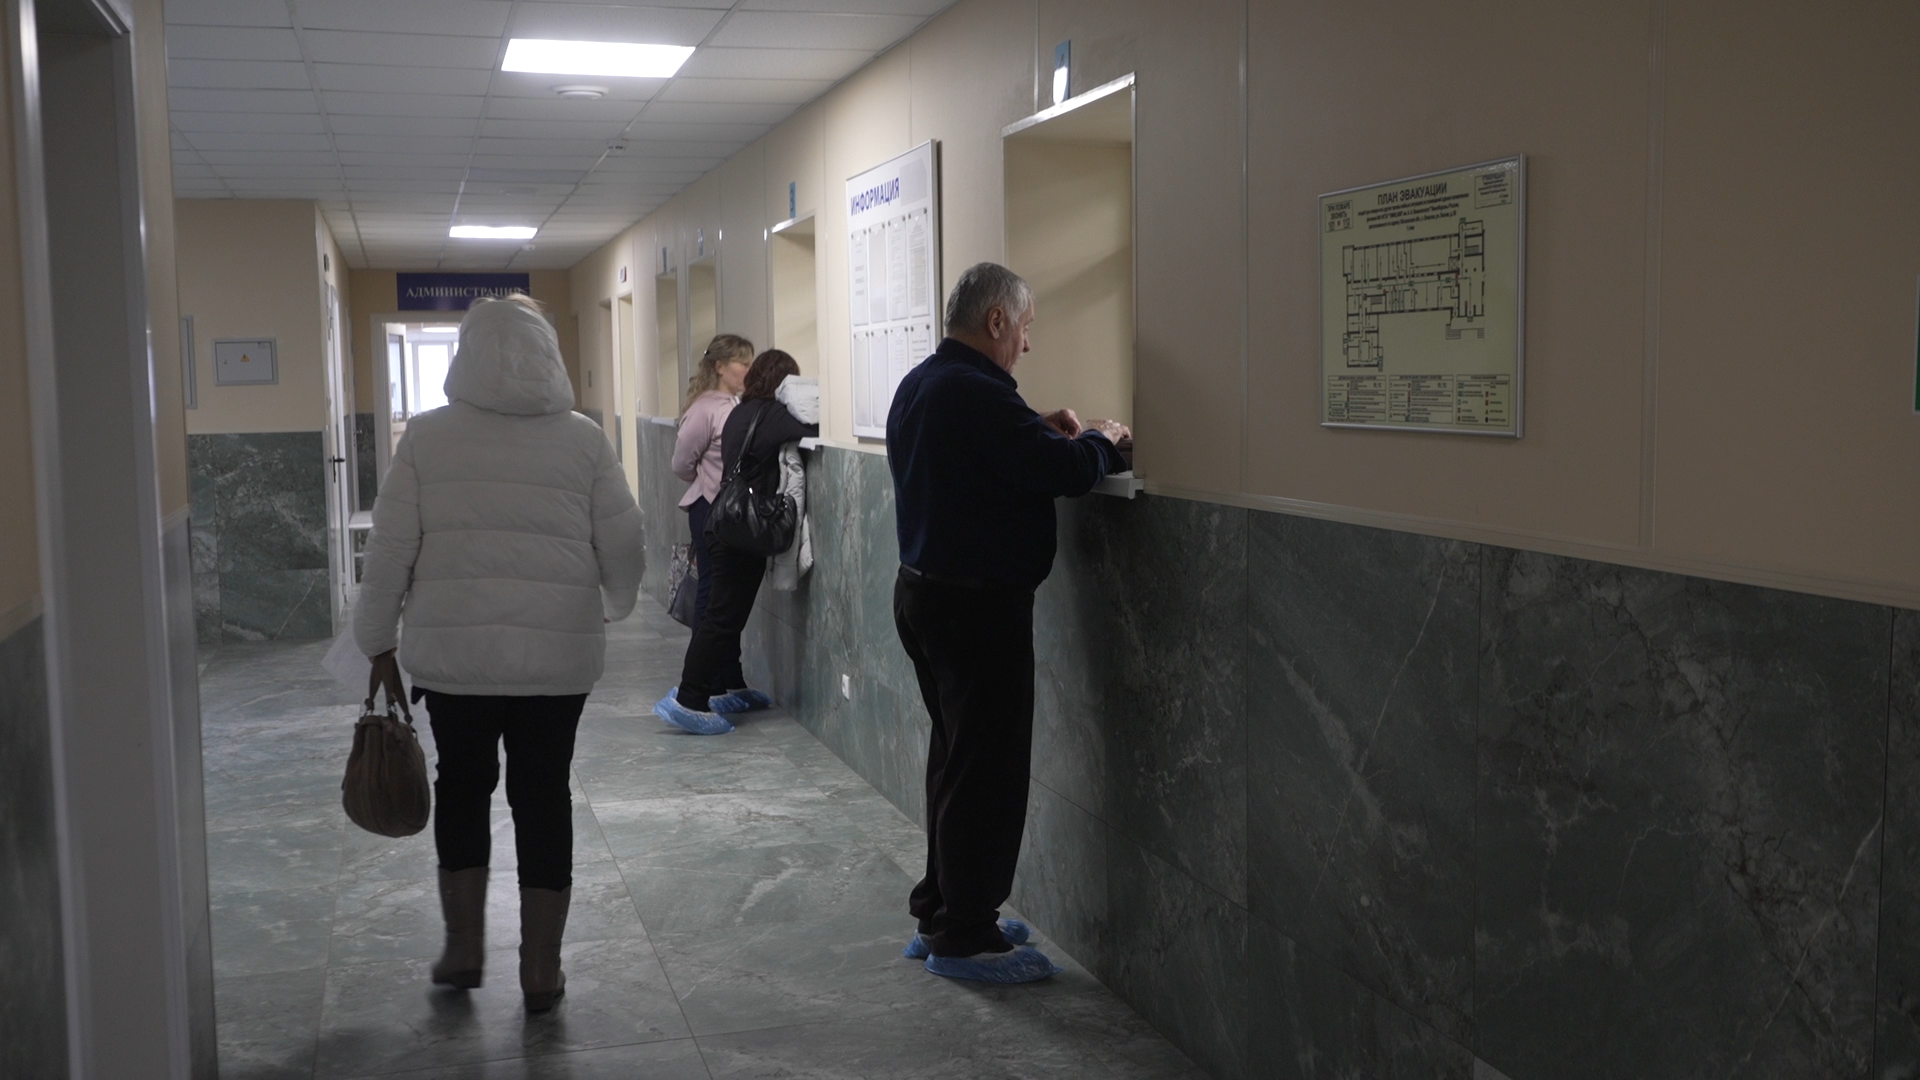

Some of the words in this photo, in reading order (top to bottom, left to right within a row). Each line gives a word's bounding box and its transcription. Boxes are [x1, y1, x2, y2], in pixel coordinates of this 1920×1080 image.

[850, 177, 900, 217] ИНФОРМАЦИЯ
[1377, 191, 1398, 205] ПЛАН
[1399, 182, 1447, 201] ЭВАКУАЦИИ
[406, 286, 520, 299] АДМИНИСТРАЦИЯ
